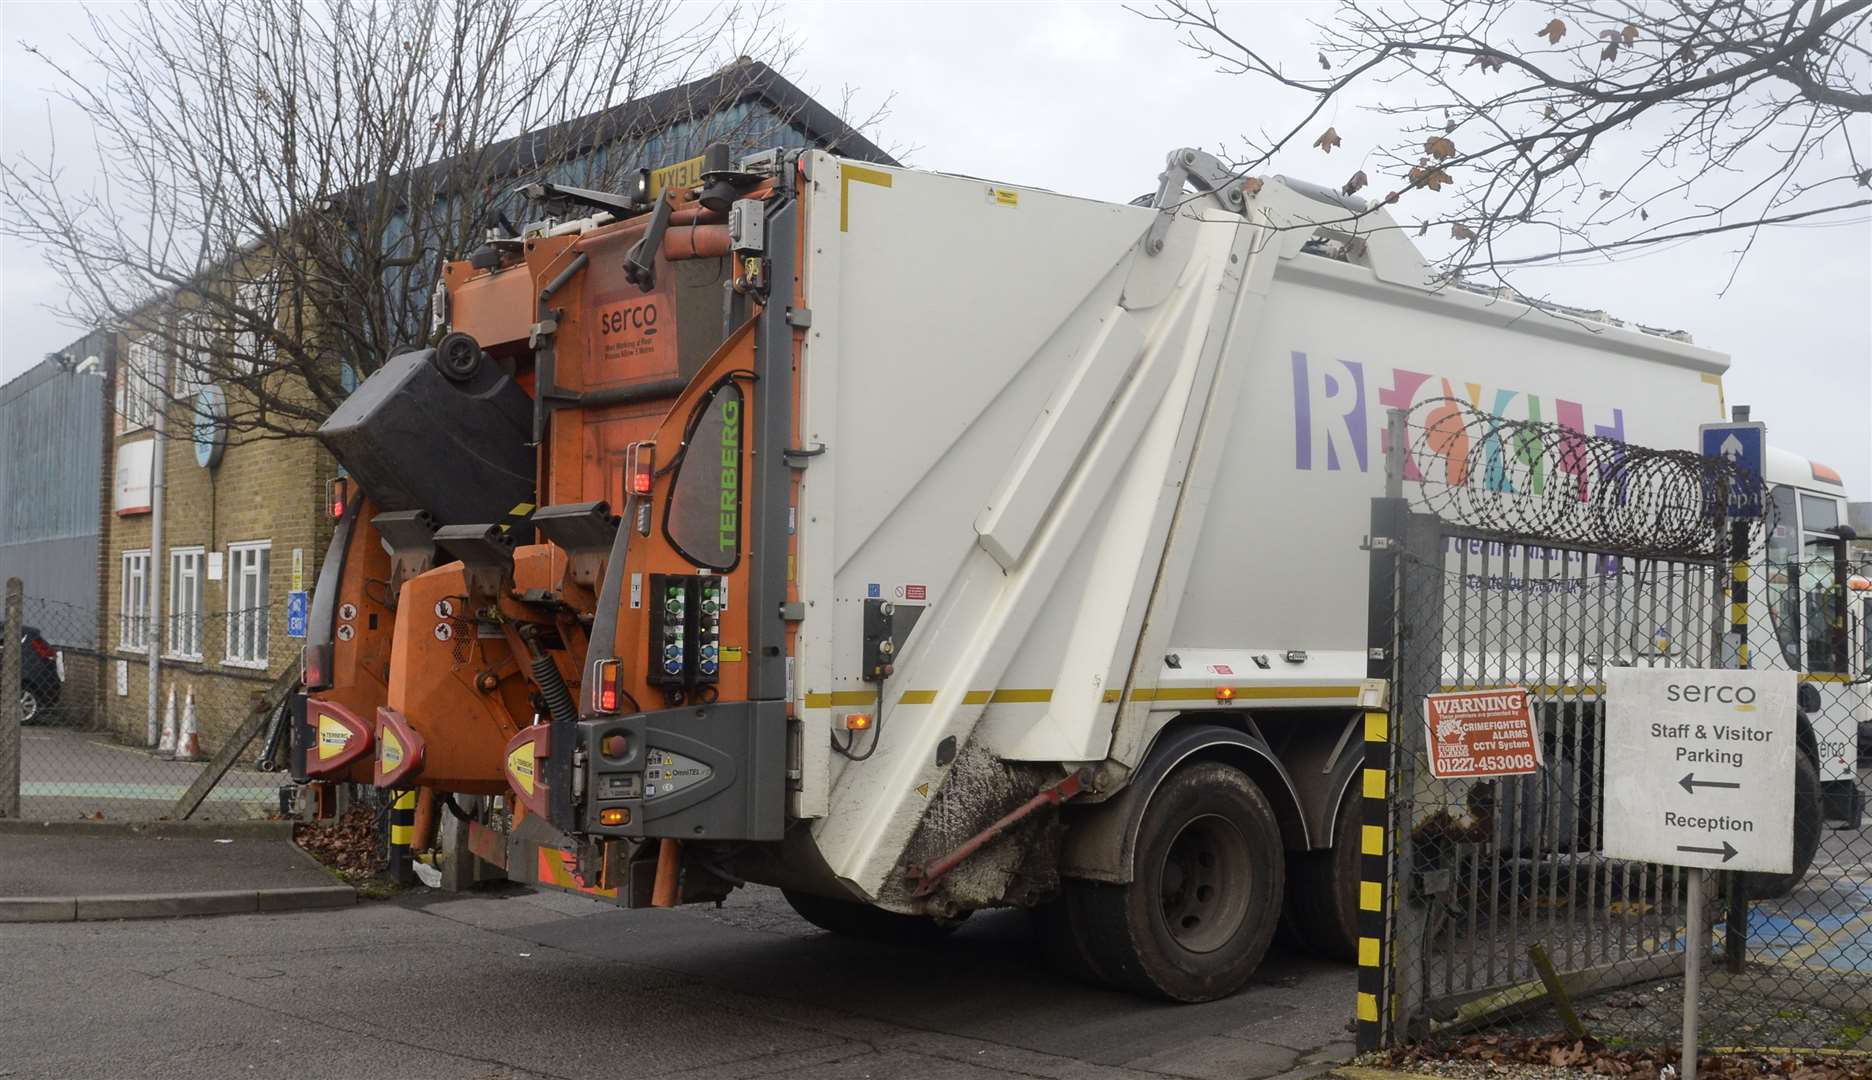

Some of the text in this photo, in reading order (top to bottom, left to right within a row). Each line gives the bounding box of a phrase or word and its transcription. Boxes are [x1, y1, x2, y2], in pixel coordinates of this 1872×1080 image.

[602, 303, 657, 336] serco
[719, 399, 739, 553] TERBERG
[1433, 695, 1522, 714] WARNING
[1667, 684, 1757, 706] serco
[1463, 720, 1527, 732] CRIMEFIGHTER
[1492, 730, 1528, 740] ALARMS
[1651, 723, 1773, 742] Staff & Visitor
[1473, 739, 1530, 751] CCTV System
[1676, 747, 1743, 767] Parking
[1665, 812, 1753, 832] Reception
